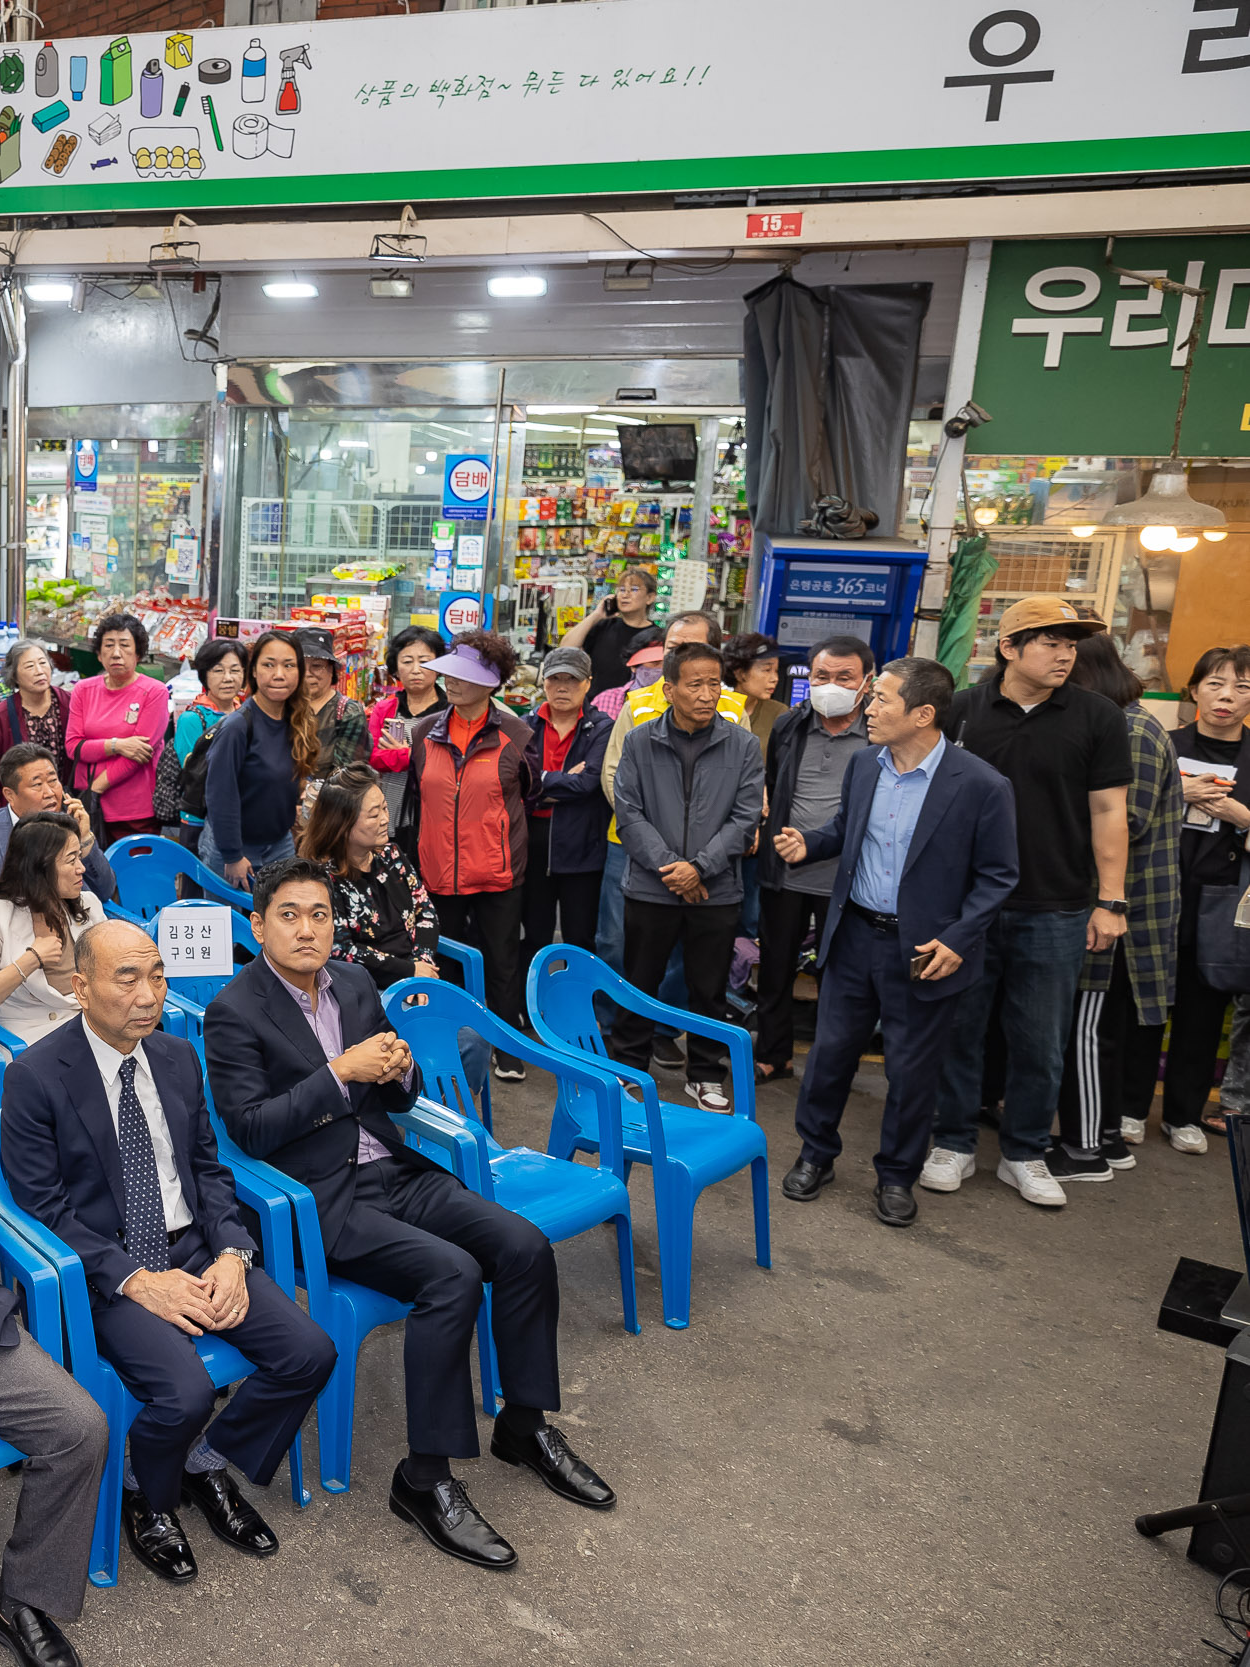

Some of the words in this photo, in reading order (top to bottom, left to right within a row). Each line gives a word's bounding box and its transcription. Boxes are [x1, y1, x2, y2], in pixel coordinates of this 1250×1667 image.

[355, 80, 420, 109] 상품의
[522, 70, 565, 98] 뭐든
[580, 74, 600, 88] 다
[612, 65, 711, 91] 있어요!!
[760, 215, 782, 231] 15
[1011, 260, 1250, 369] 우리
[455, 471, 488, 488] 담배
[790, 579, 833, 592] 은행공동
[834, 577, 867, 595] 365
[865, 583, 887, 594] 코너
[171, 946, 211, 960] 구의원
